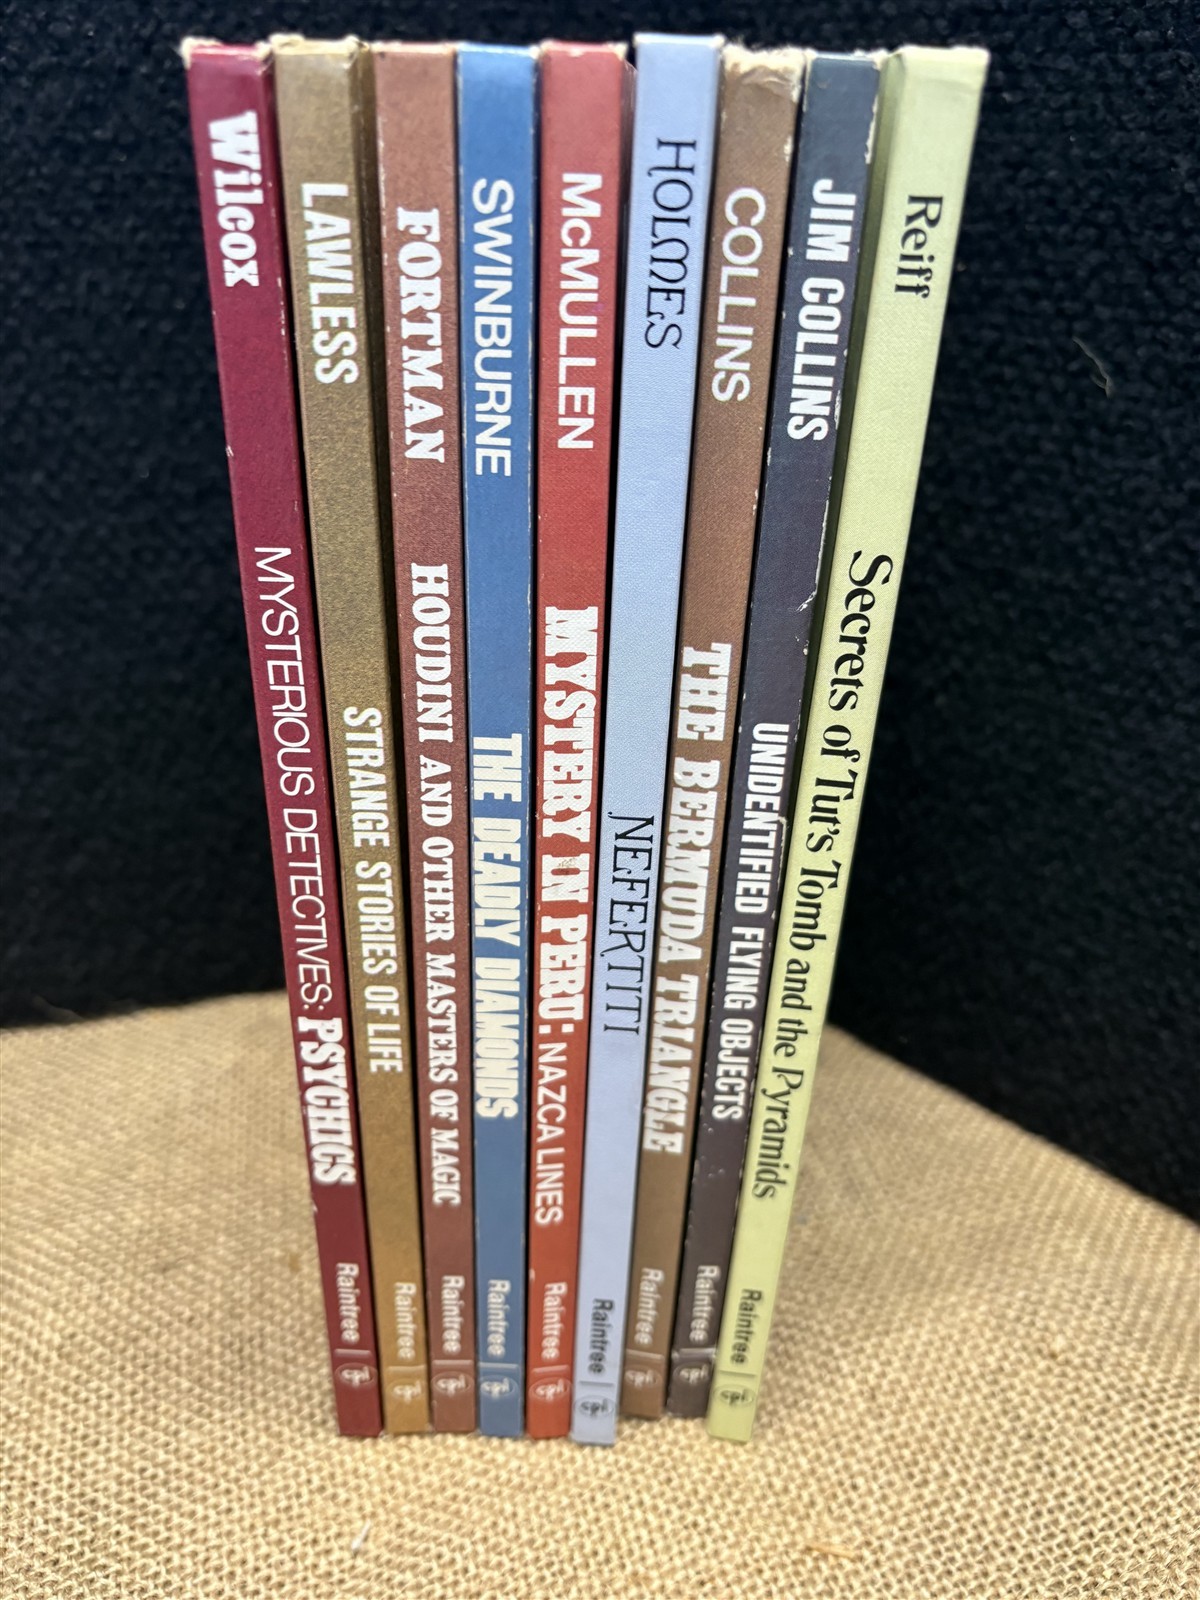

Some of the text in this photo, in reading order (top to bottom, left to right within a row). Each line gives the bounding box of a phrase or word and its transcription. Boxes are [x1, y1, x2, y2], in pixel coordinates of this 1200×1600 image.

[208, 111, 263, 287] Wilcox
[301, 183, 359, 384] LAWLESS
[645, 137, 697, 349] HOLMES
[894, 194, 944, 298] Reiff
[397, 206, 446, 463] FORTMAN
[472, 178, 515, 477] SWINBURNE
[557, 172, 602, 449] McMULLEN
[711, 187, 766, 402] COLLINS
[787, 178, 857, 441] JIM COLLINS
[828, 550, 894, 712] Secrets
[820, 724, 860, 763] of
[254, 547, 356, 1185] MYSTERIOUS DETECTIVES: PSYCHICS
[343, 706, 403, 1074] STRANGE STORIES OF LIFE
[411, 562, 462, 1206] HOUDINI AND OTHER MASTERS OF MAGIC
[472, 733, 522, 1120] THE DEADLY DIAMONDS
[534, 606, 598, 1225] MYSTERY IN PERU: NAZCA LINES
[600, 811, 655, 1035] NEFERTITI
[643, 642, 732, 1155] THE BERMUDA TRIANGLE
[711, 722, 790, 1121] UNIDENTIFIED FLYING OBJECTS
[789, 860, 842, 951] Tomb
[773, 1017, 808, 1058] the
[780, 957, 812, 1011] and
[752, 1065, 804, 1199] Pyramids
[335, 1262, 360, 1345] Raintree
[394, 1282, 417, 1360] Raintree
[441, 1275, 465, 1355] Raintree
[487, 1279, 511, 1358] Raintree
[541, 1282, 567, 1360] Raintree
[588, 1298, 614, 1375] Raintree
[635, 1267, 664, 1345] Raintree
[689, 1264, 720, 1342] Raintree
[730, 1288, 762, 1365] Raintree
